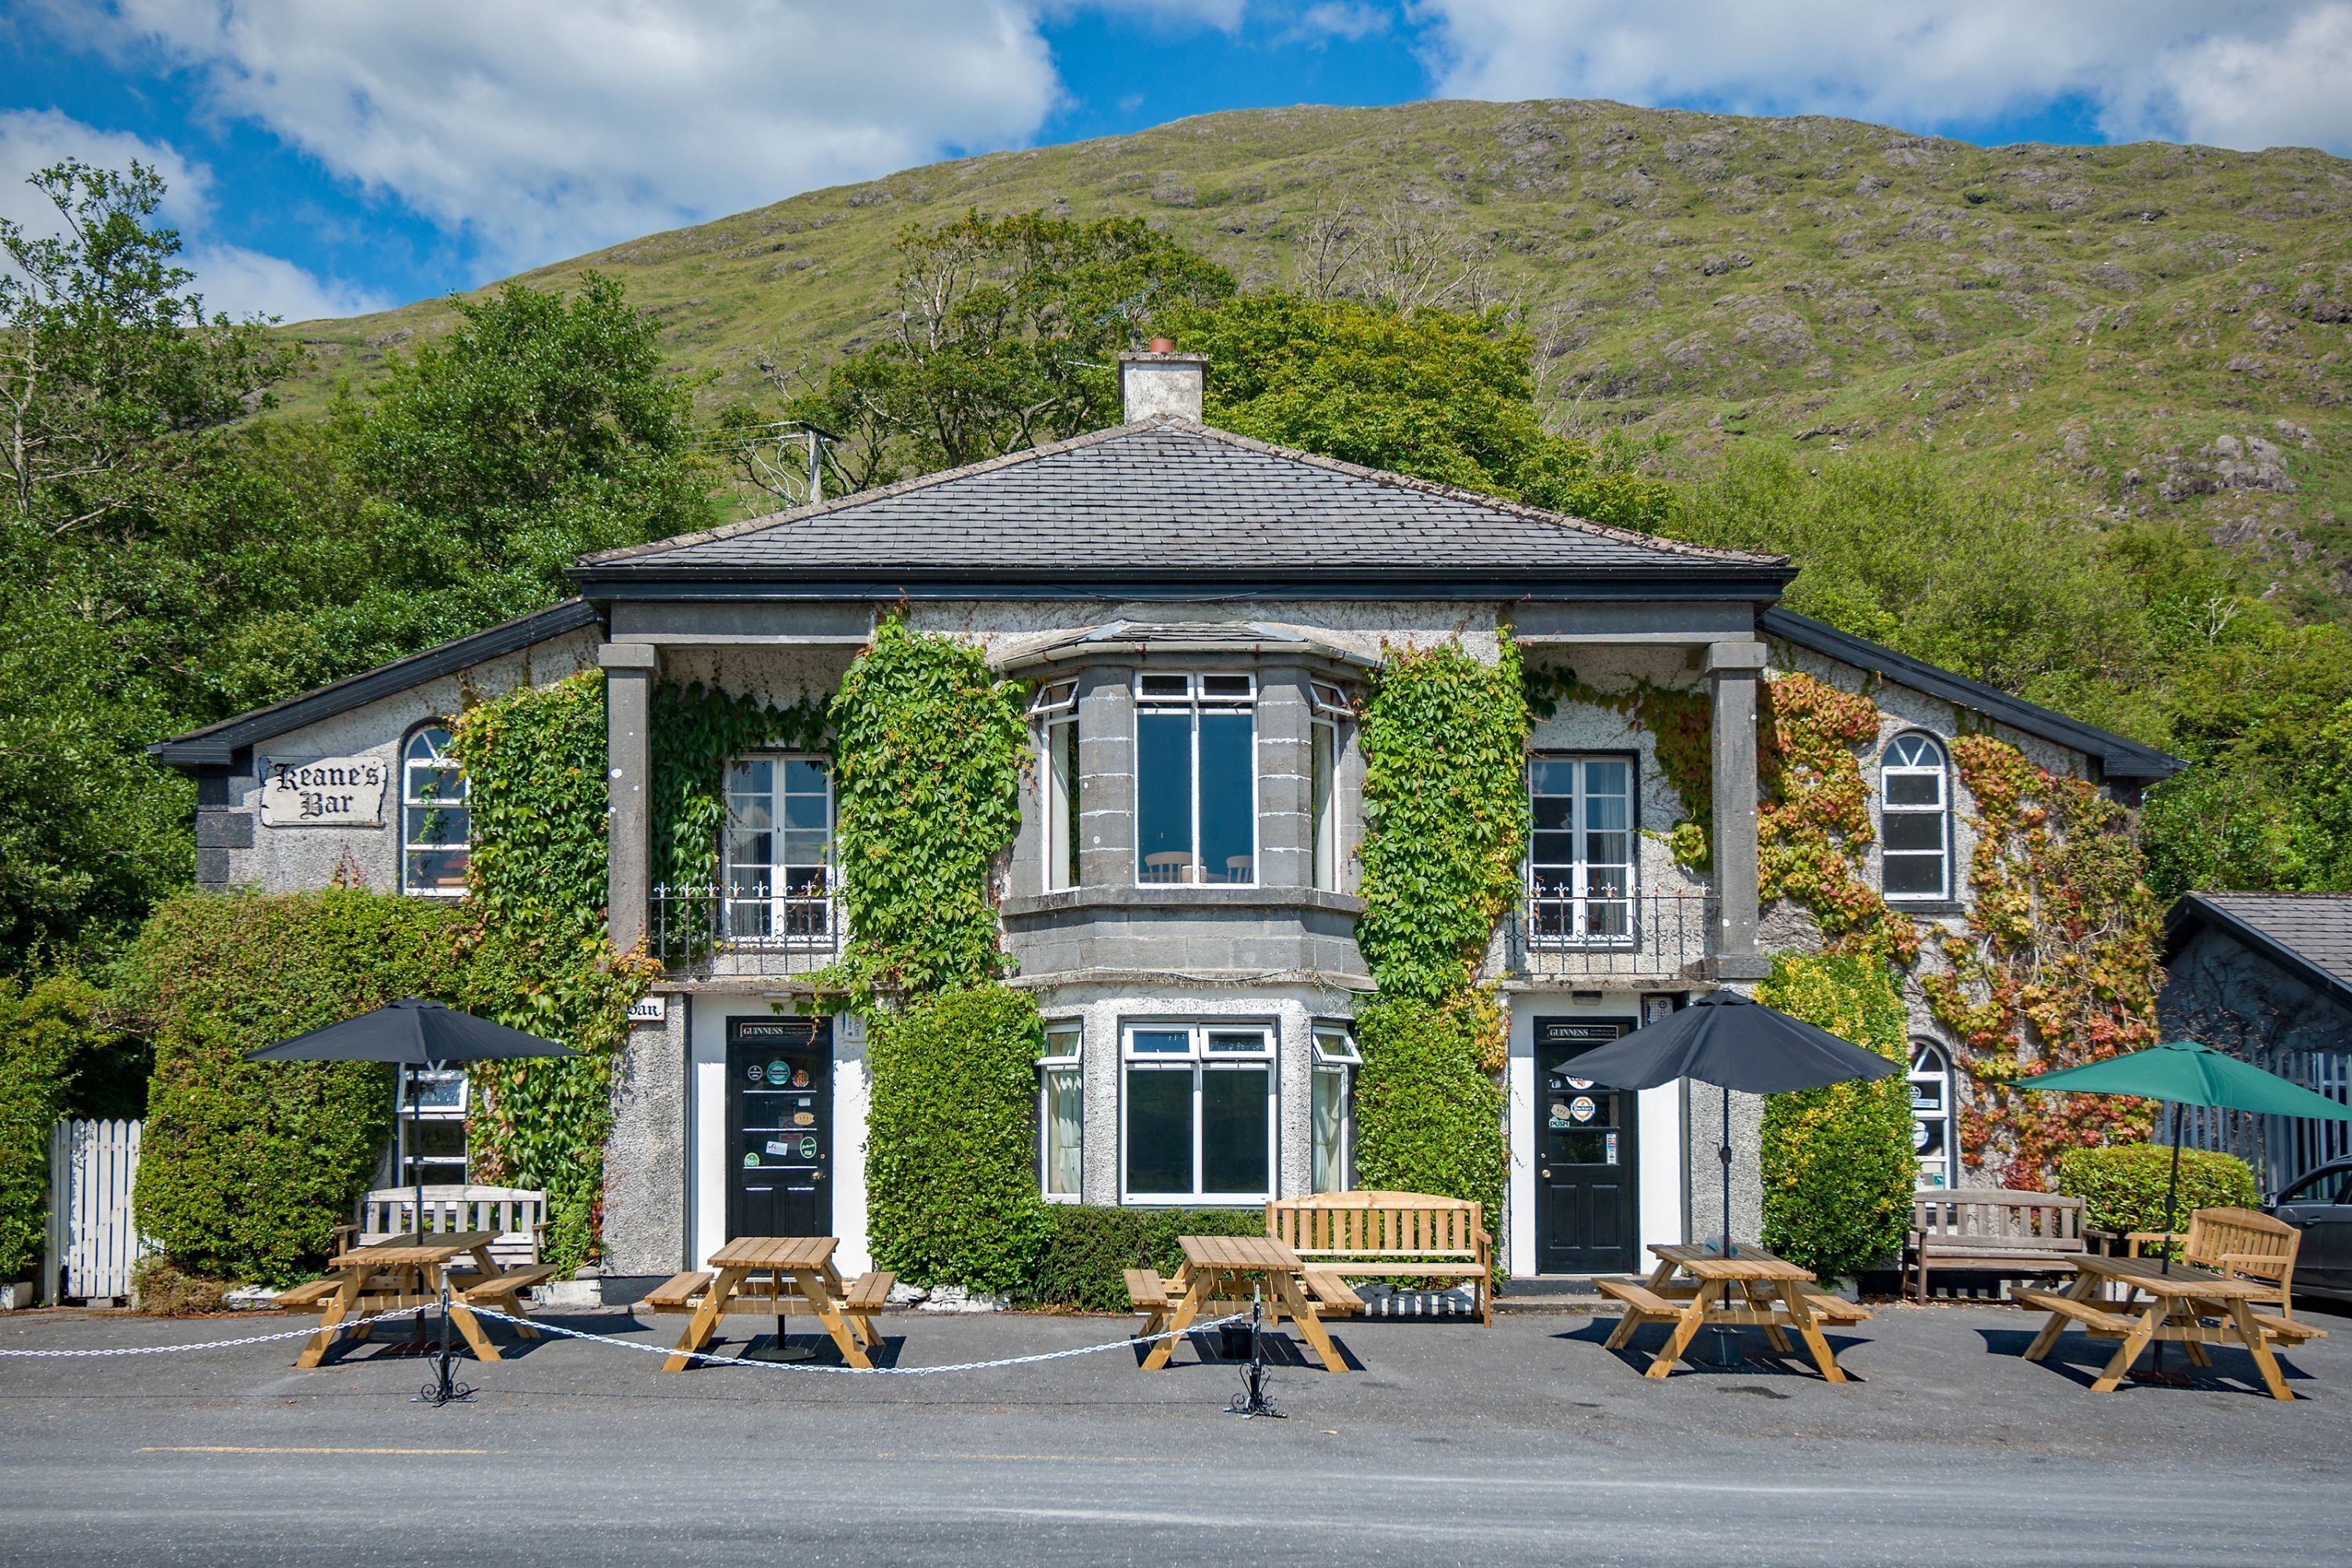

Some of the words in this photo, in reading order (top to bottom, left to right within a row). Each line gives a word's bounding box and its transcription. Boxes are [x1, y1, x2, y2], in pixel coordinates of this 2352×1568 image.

[274, 763, 379, 791] Keane's
[299, 791, 354, 819] Bar
[1550, 1028, 1588, 1036] GUINNESS
